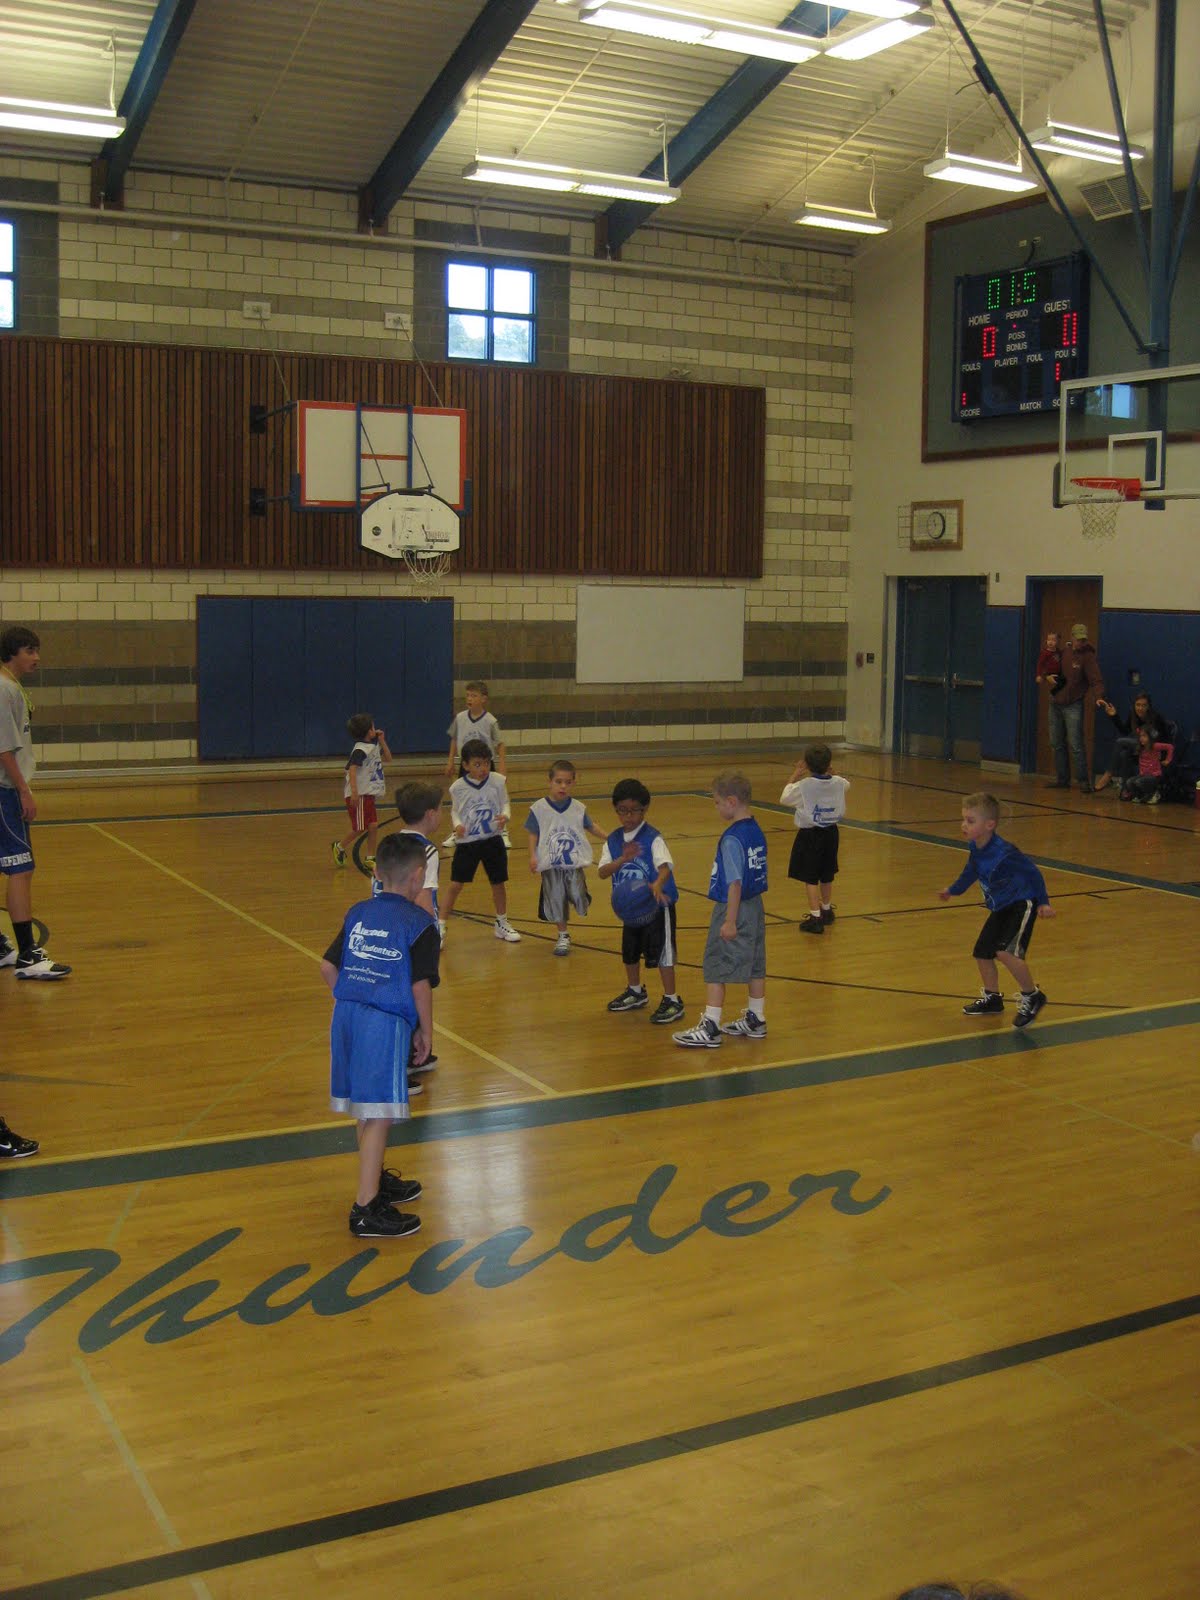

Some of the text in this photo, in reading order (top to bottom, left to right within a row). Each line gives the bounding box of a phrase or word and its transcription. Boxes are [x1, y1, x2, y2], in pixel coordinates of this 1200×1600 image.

[1044, 299, 1070, 314] GUEST
[968, 313, 991, 327] HOME
[1005, 309, 1029, 320] PERIOD
[1008, 331, 1026, 341] POSS
[982, 326, 997, 358] 0
[1006, 342, 1028, 352] BONUS
[1026, 353, 1043, 363] FOUL
[1055, 348, 1077, 359] FOUS
[961, 362, 981, 372] FOULS
[994, 356, 1019, 368] PLAYER
[1019, 401, 1042, 411] MATCH
[1052, 396, 1075, 407] SCE
[960, 407, 981, 418] SCORE
[0, 1163, 893, 1365] Thunder
